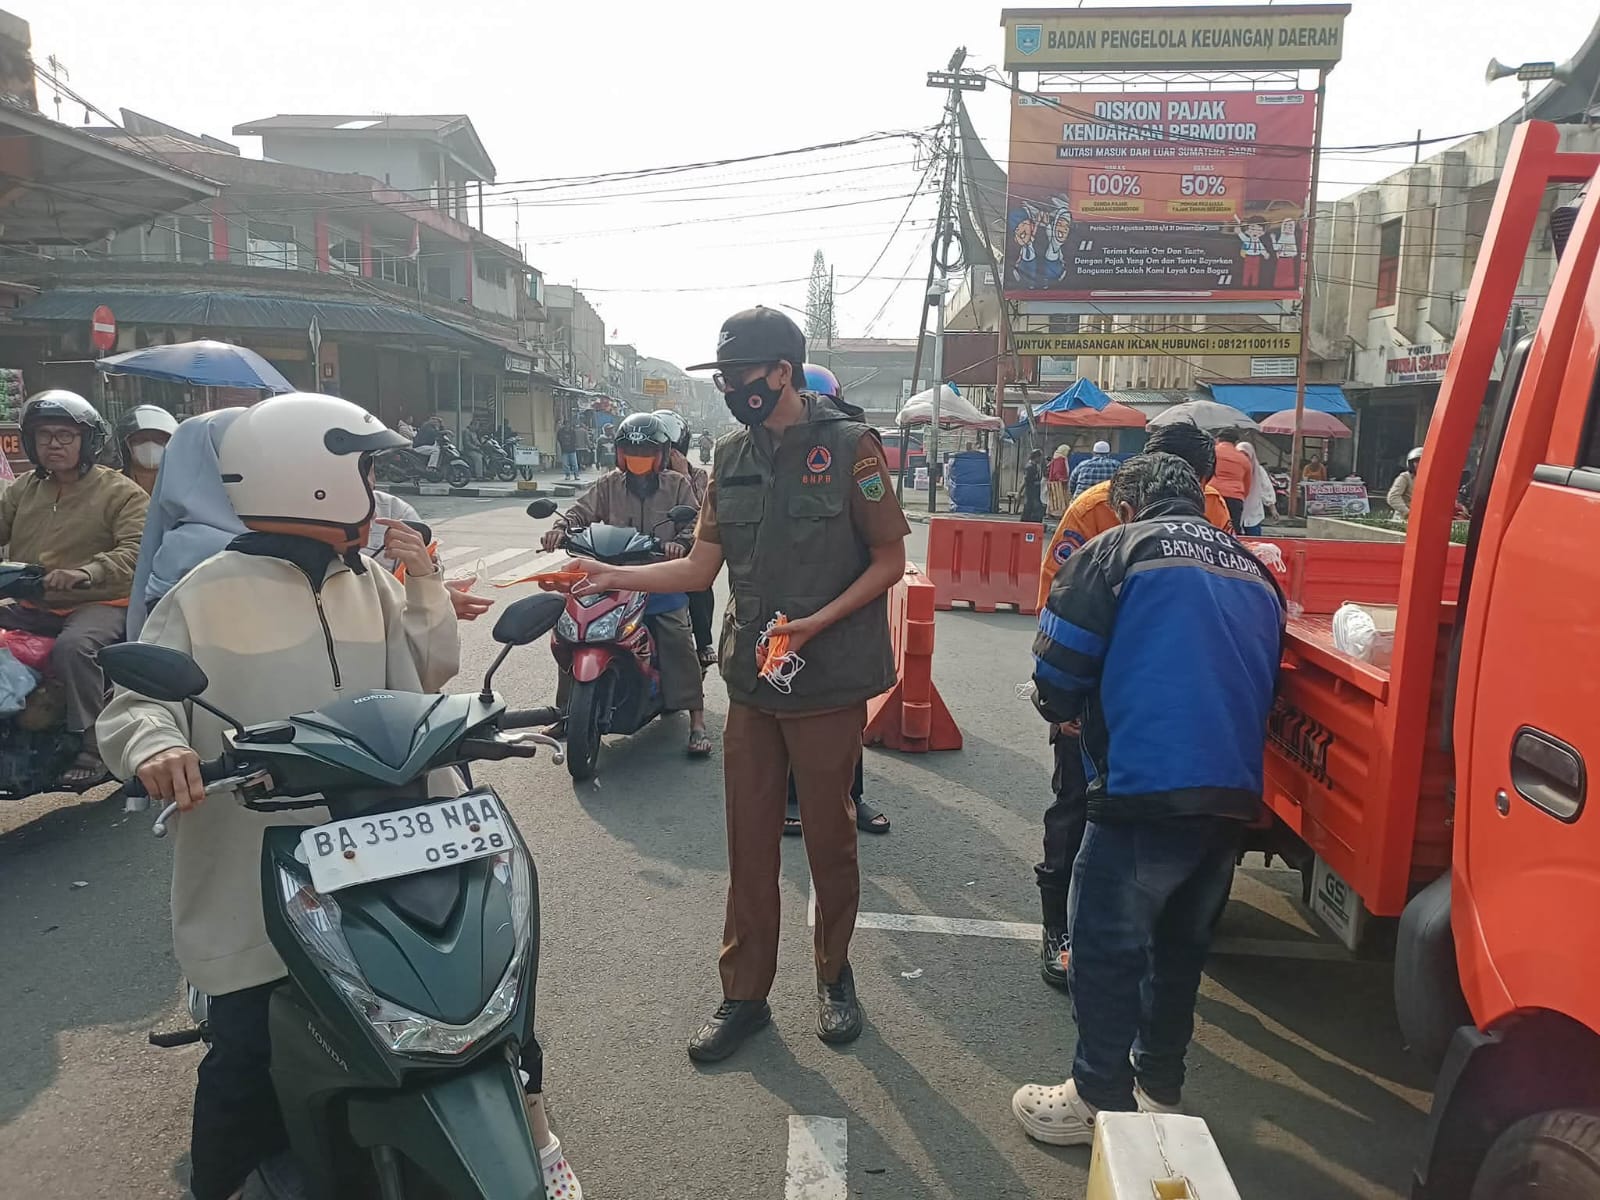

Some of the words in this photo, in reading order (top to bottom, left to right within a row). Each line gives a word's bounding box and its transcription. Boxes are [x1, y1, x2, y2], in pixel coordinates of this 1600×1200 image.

[1047, 30, 1097, 49] BADAN
[1101, 29, 1187, 49] PENGELOLA
[1191, 28, 1274, 48] KEUANGAN
[1278, 27, 1338, 47] DAERAH
[1094, 101, 1160, 121] DISKON
[1167, 100, 1226, 120] PAJAK
[1063, 123, 1164, 141] KENDARAAN
[1168, 123, 1257, 141] BERMOTOR
[1060, 147, 1093, 157] MUTASI
[1095, 147, 1127, 157] MASUK
[1130, 147, 1151, 157] DARI
[1153, 147, 1176, 157] LUAR
[1088, 174, 1142, 195] 100%
[1180, 174, 1226, 195] 50%
[1102, 247, 1128, 255] Terima
[1130, 247, 1150, 255] Kasih
[1151, 247, 1165, 255] Om
[1167, 247, 1182, 255] Dan
[1074, 257, 1103, 266] Dengan
[1104, 257, 1124, 266] Pajak
[1126, 257, 1144, 266] Yang
[1077, 266, 1114, 276] Bangunan
[1115, 266, 1144, 274] Sekolah
[1146, 266, 1165, 274] Kami
[1166, 266, 1189, 276] Layak
[1206, 267, 1229, 276] Bagus
[1016, 339, 1053, 350] UNTUK
[1054, 339, 1125, 350] PEMASANGAN
[1127, 339, 1159, 350] IKLAN
[1161, 338, 1210, 350] HUBUNGI
[1217, 338, 1291, 350] 081211001115
[1160, 539, 1215, 565] BATANG
[1218, 550, 1262, 577] GADIH
[353, 694, 395, 705] HONDA
[313, 826, 358, 857] BA
[361, 812, 435, 846] 3538
[441, 799, 500, 830] NAA
[1325, 872, 1345, 906] GS
[307, 1020, 349, 1073] HONDA
